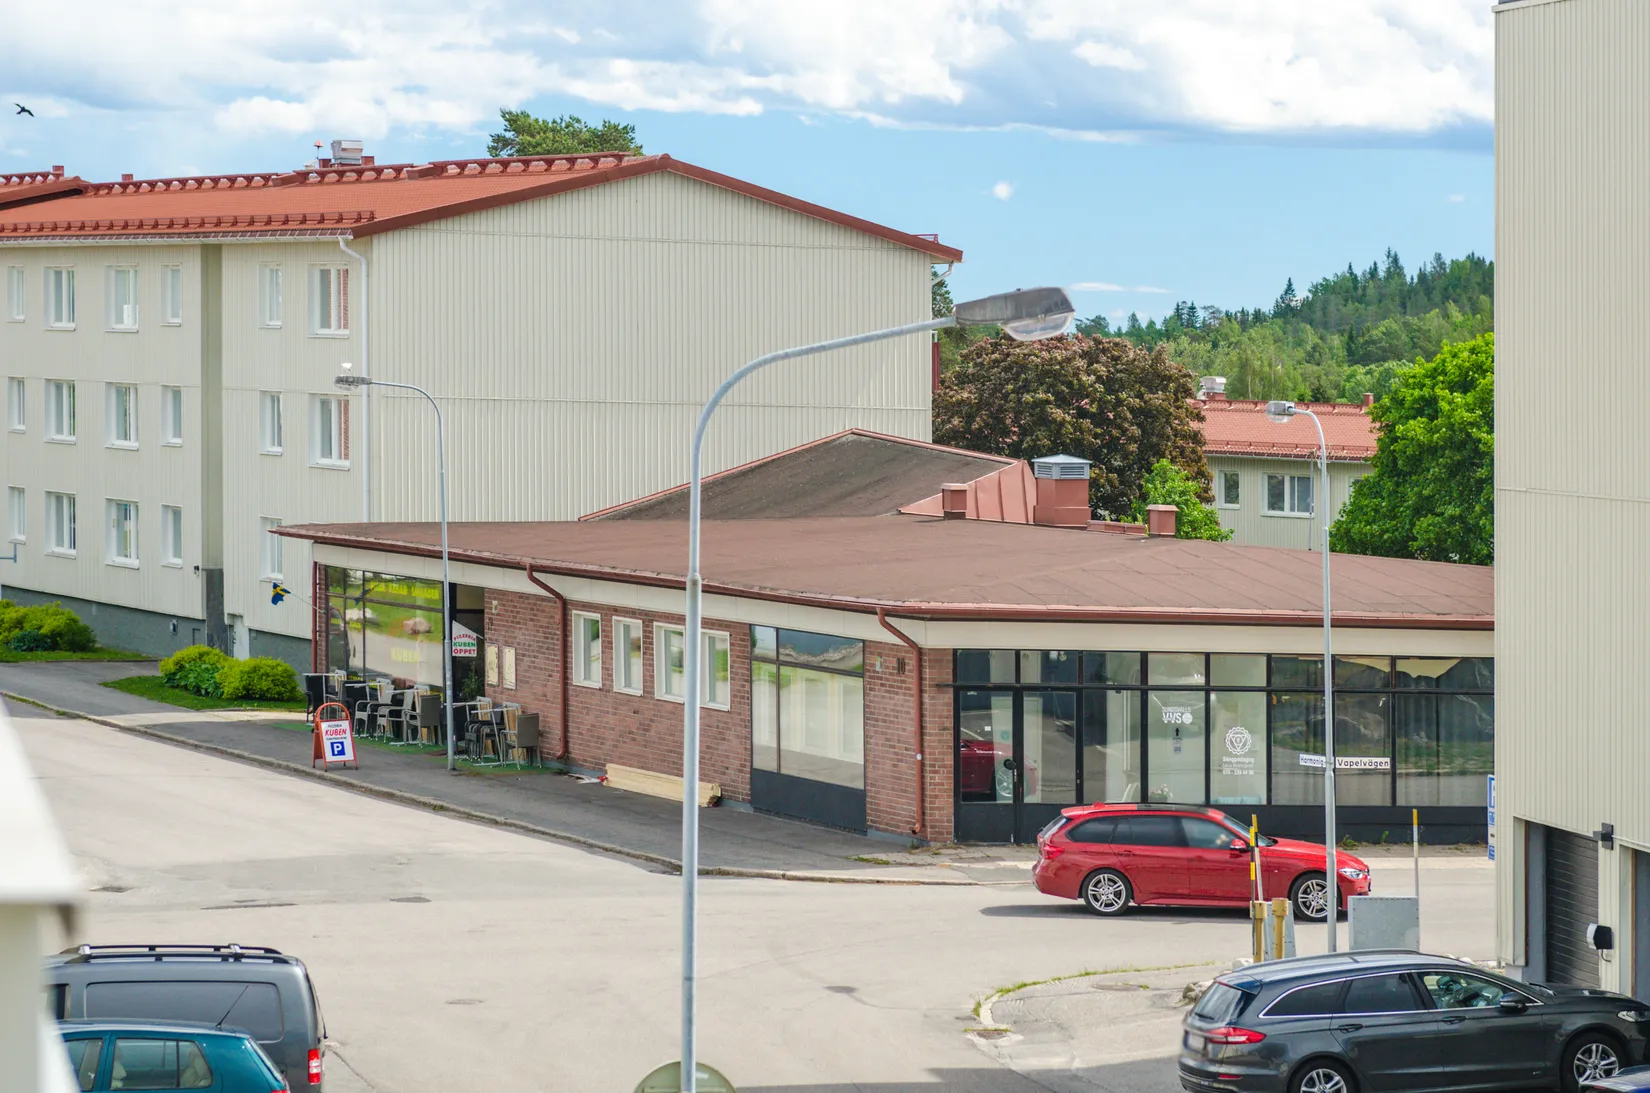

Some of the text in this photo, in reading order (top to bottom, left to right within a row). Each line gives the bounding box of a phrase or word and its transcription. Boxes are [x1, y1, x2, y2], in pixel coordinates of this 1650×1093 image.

[1162, 712, 1182, 723] VVS
[325, 728, 347, 736] KUBEN
[333, 743, 342, 754] P
[1337, 758, 1389, 768] Vapelvägen
